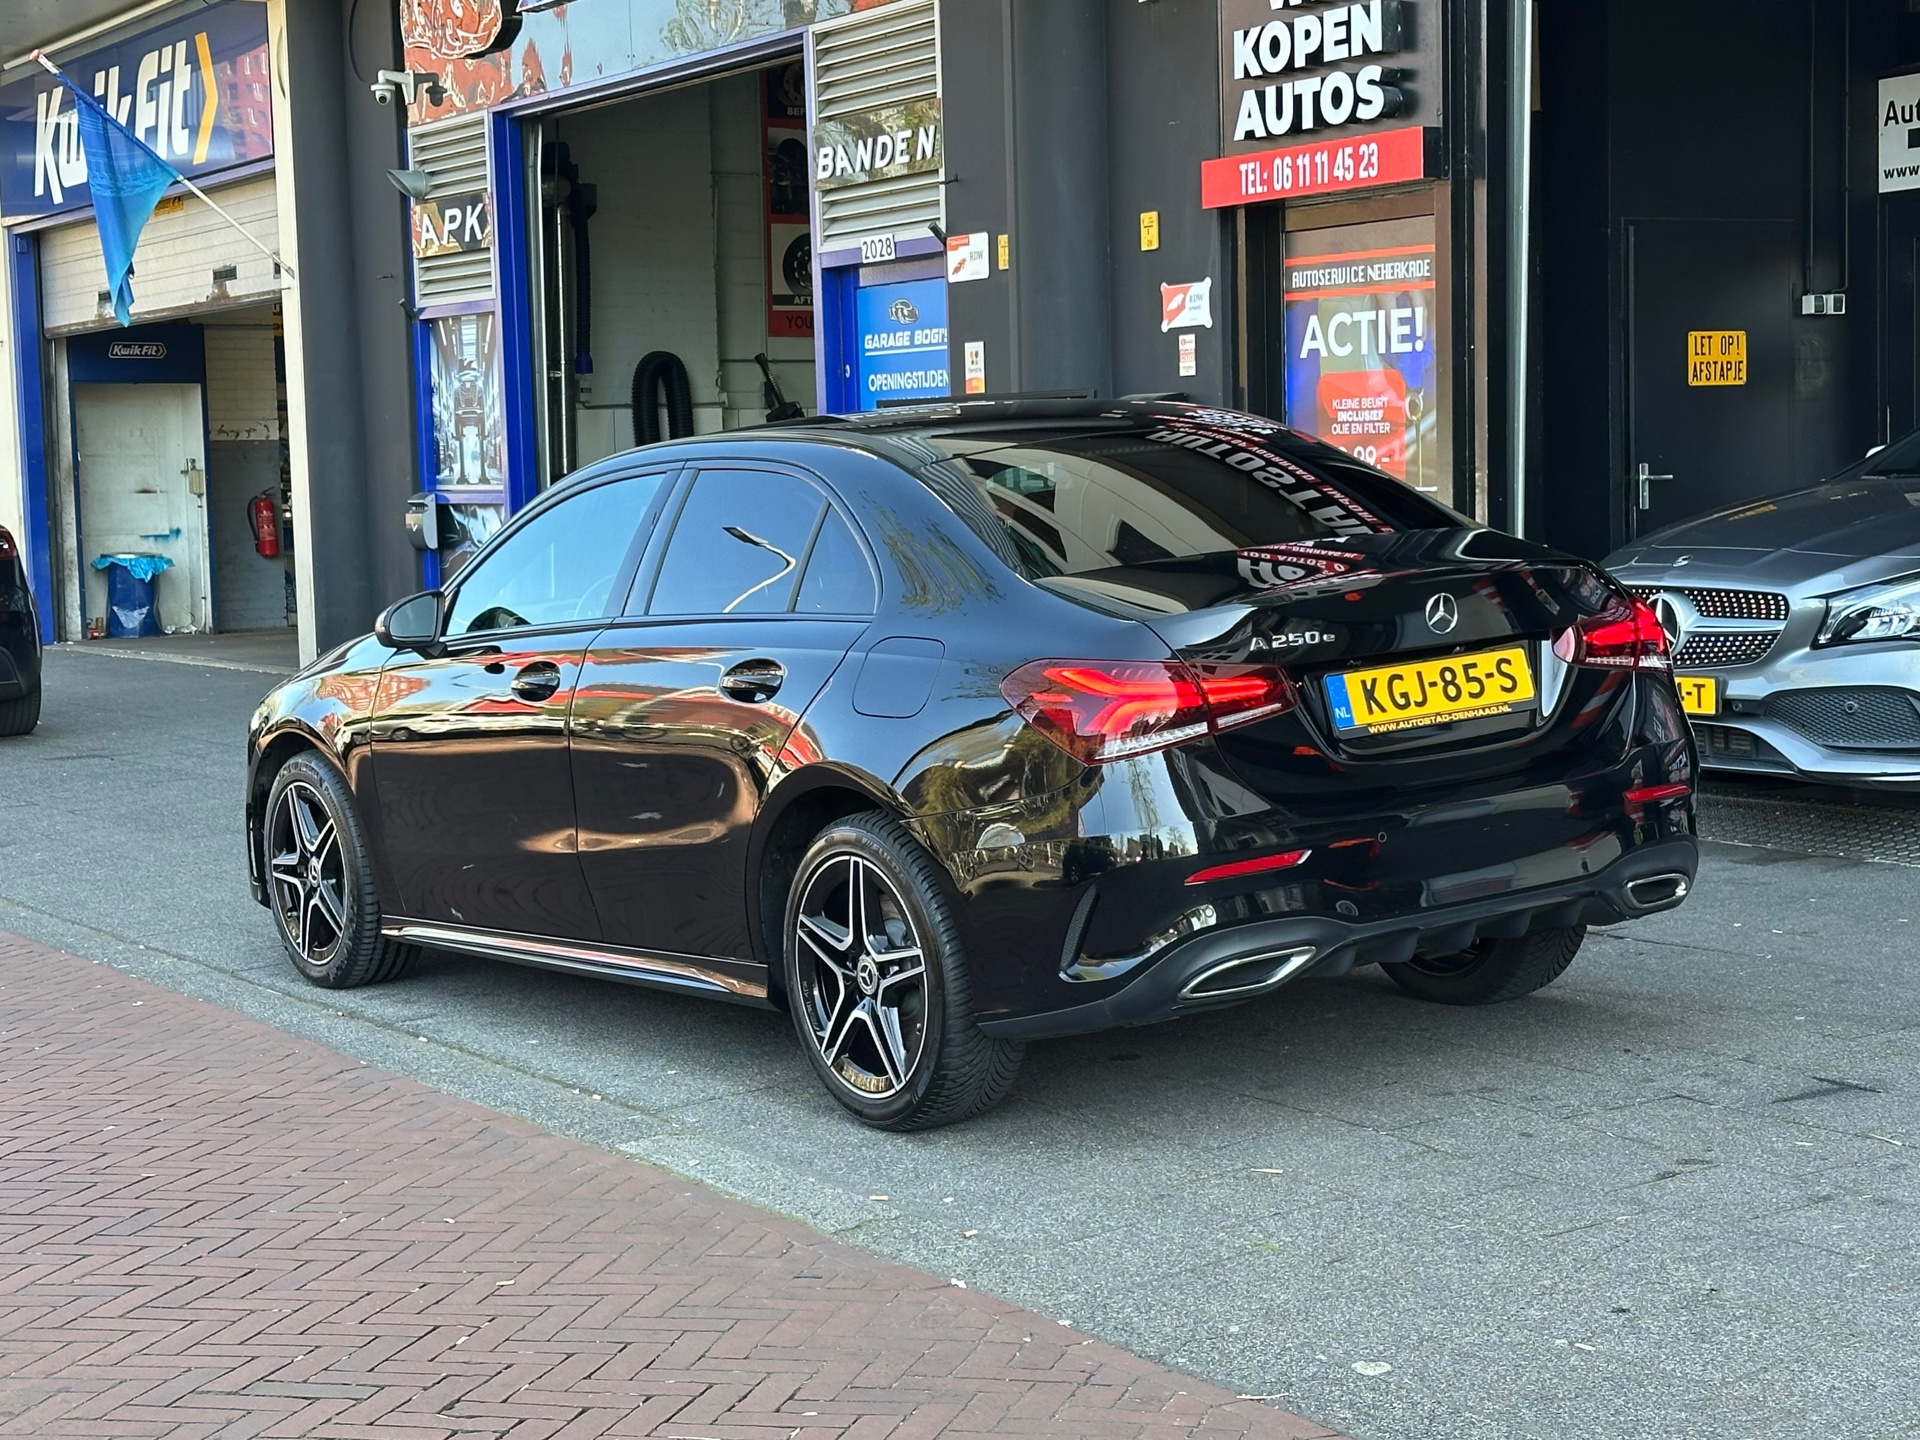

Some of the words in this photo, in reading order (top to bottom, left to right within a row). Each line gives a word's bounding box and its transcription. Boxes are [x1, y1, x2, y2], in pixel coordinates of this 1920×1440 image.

[1233, 0, 1383, 80] KOPEN
[1233, 65, 1385, 141] AUTOS
[817, 125, 936, 180] BANDEN
[1239, 162, 1268, 196] TEL:
[1273, 156, 1293, 193] 06
[1297, 153, 1310, 188] 11
[1315, 150, 1329, 185] 11
[1333, 146, 1354, 182] 45
[1358, 142, 1378, 179] 23
[421, 203, 484, 249] APK
[862, 237, 893, 260] 2028
[1292, 265, 1365, 289] AUTOSERVICE
[1367, 259, 1431, 281] NEHERKADE
[864, 331, 911, 350] GARAGE
[1300, 306, 1424, 359] ACTIE!
[1694, 335, 1713, 356] LET
[1720, 335, 1740, 356] OP!
[868, 369, 948, 392] OPENINGSTIJDEN
[1692, 360, 1744, 382] AFSTAPJE
[1332, 398, 1360, 410] KLEINE
[1361, 396, 1389, 409] BEURT
[1337, 410, 1384, 422] INCLUSIEF
[1331, 424, 1350, 435] OLIE
[1351, 423, 1363, 434] EN
[1364, 422, 1391, 434] FILTER
[1361, 657, 1518, 716] KGJ-85-S
[1335, 706, 1351, 719] NL
